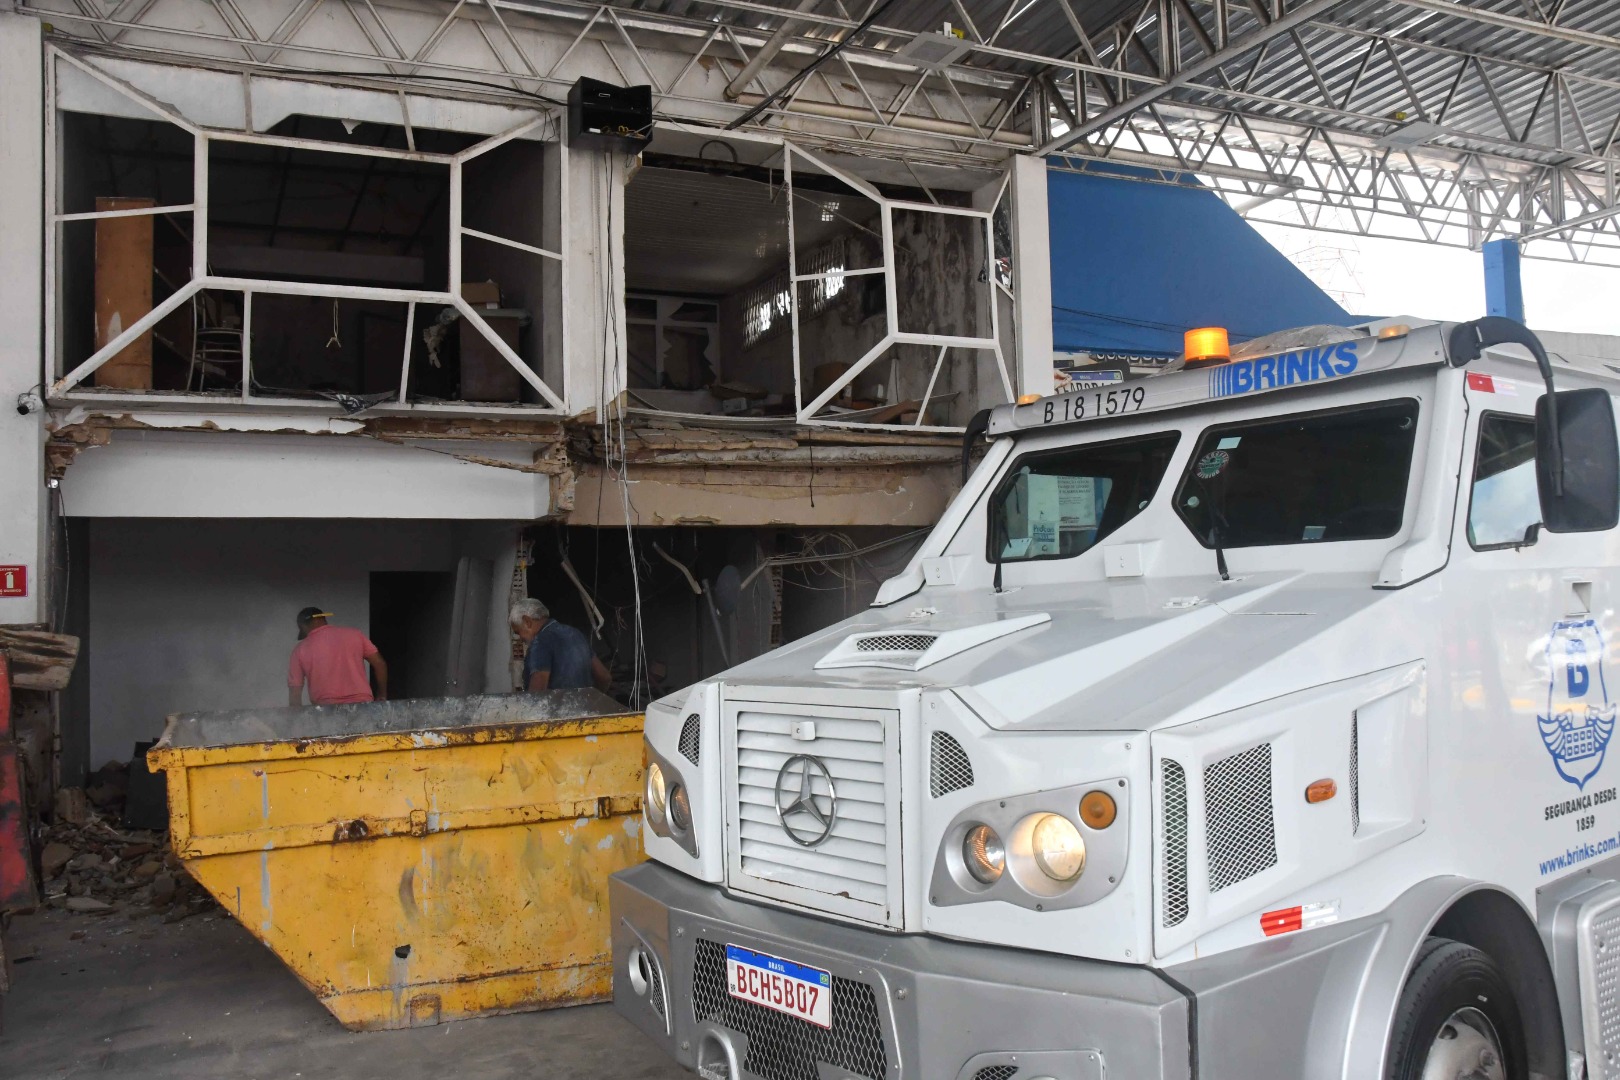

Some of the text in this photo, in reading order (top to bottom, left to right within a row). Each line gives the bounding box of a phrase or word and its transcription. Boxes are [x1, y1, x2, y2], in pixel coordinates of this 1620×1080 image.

[1231, 341, 1359, 395] BRINKS
[1044, 401, 1054, 424] B
[1064, 396, 1085, 422] 18
[1095, 386, 1146, 417] 1579
[1544, 787, 1617, 821] SEGURANÇA DESDE
[1576, 814, 1595, 832] 1859
[768, 961, 785, 973] BRASIL
[736, 964, 819, 1016] BCH5B07
